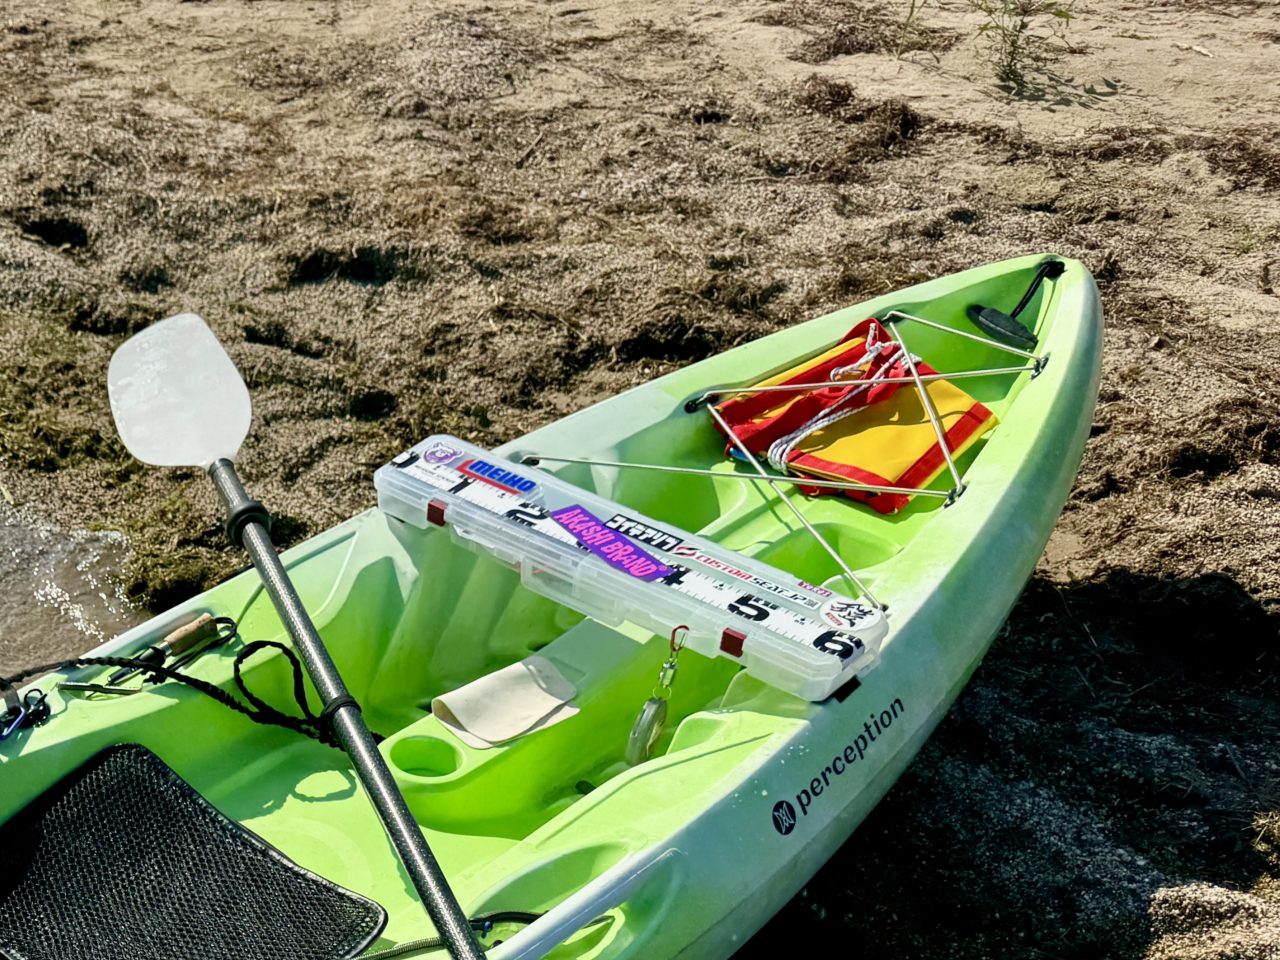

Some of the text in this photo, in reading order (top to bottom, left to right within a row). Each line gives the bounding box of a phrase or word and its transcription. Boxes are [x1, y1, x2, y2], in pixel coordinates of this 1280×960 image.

[554, 508, 616, 546] AKASHI
[694, 554, 753, 581] CUSTOM
[728, 593, 780, 621] 5
[813, 630, 865, 660] 6
[796, 698, 905, 816] perception
